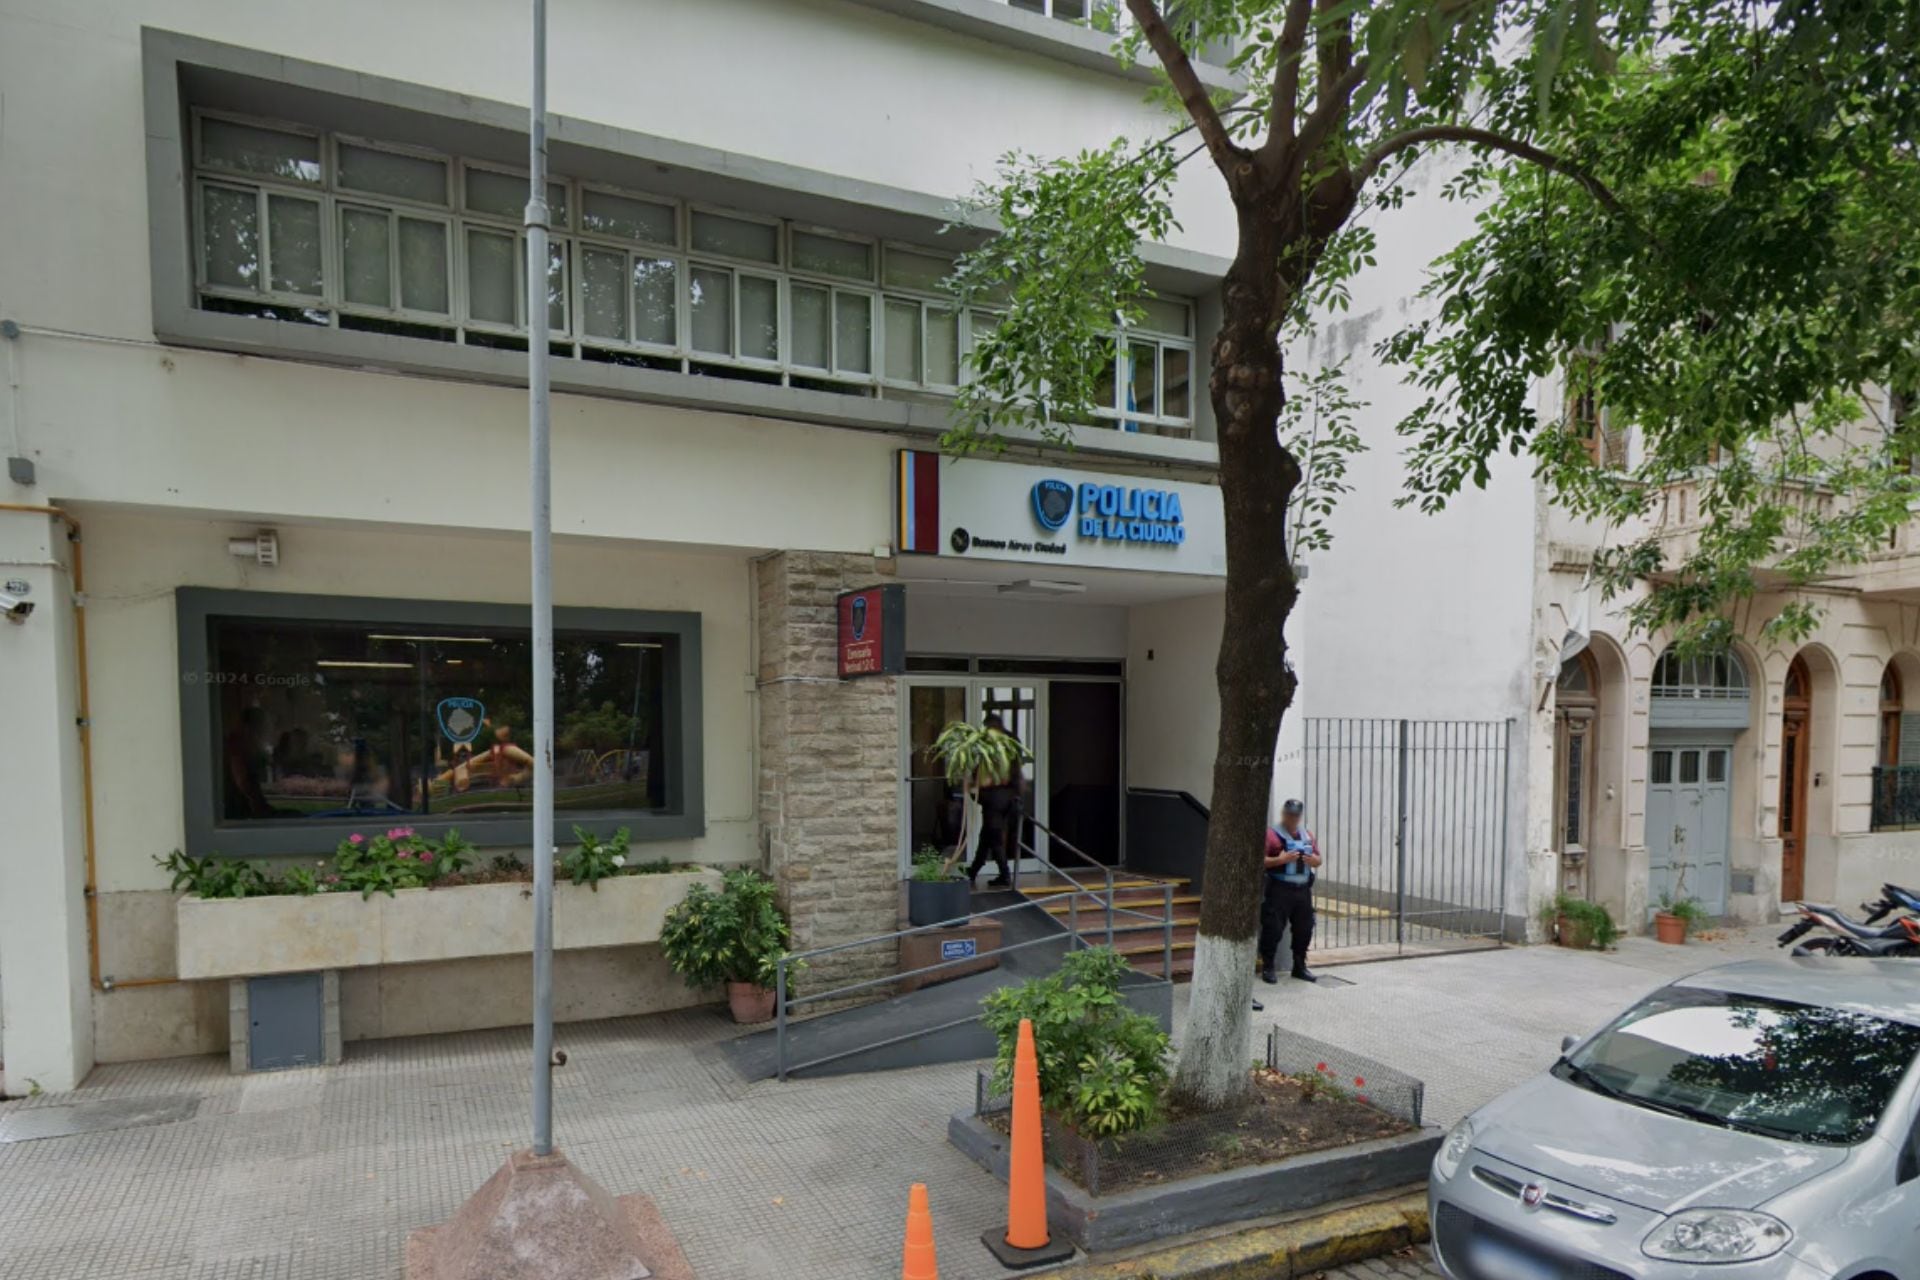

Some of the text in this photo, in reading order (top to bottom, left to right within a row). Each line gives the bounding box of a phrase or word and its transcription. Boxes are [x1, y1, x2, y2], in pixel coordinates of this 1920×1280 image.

[1080, 483, 1184, 523] POLICIA
[1080, 518, 1185, 545] DE LA CIUDAD
[973, 537, 1006, 549] Buenos
[1034, 541, 1067, 554] Ciudad
